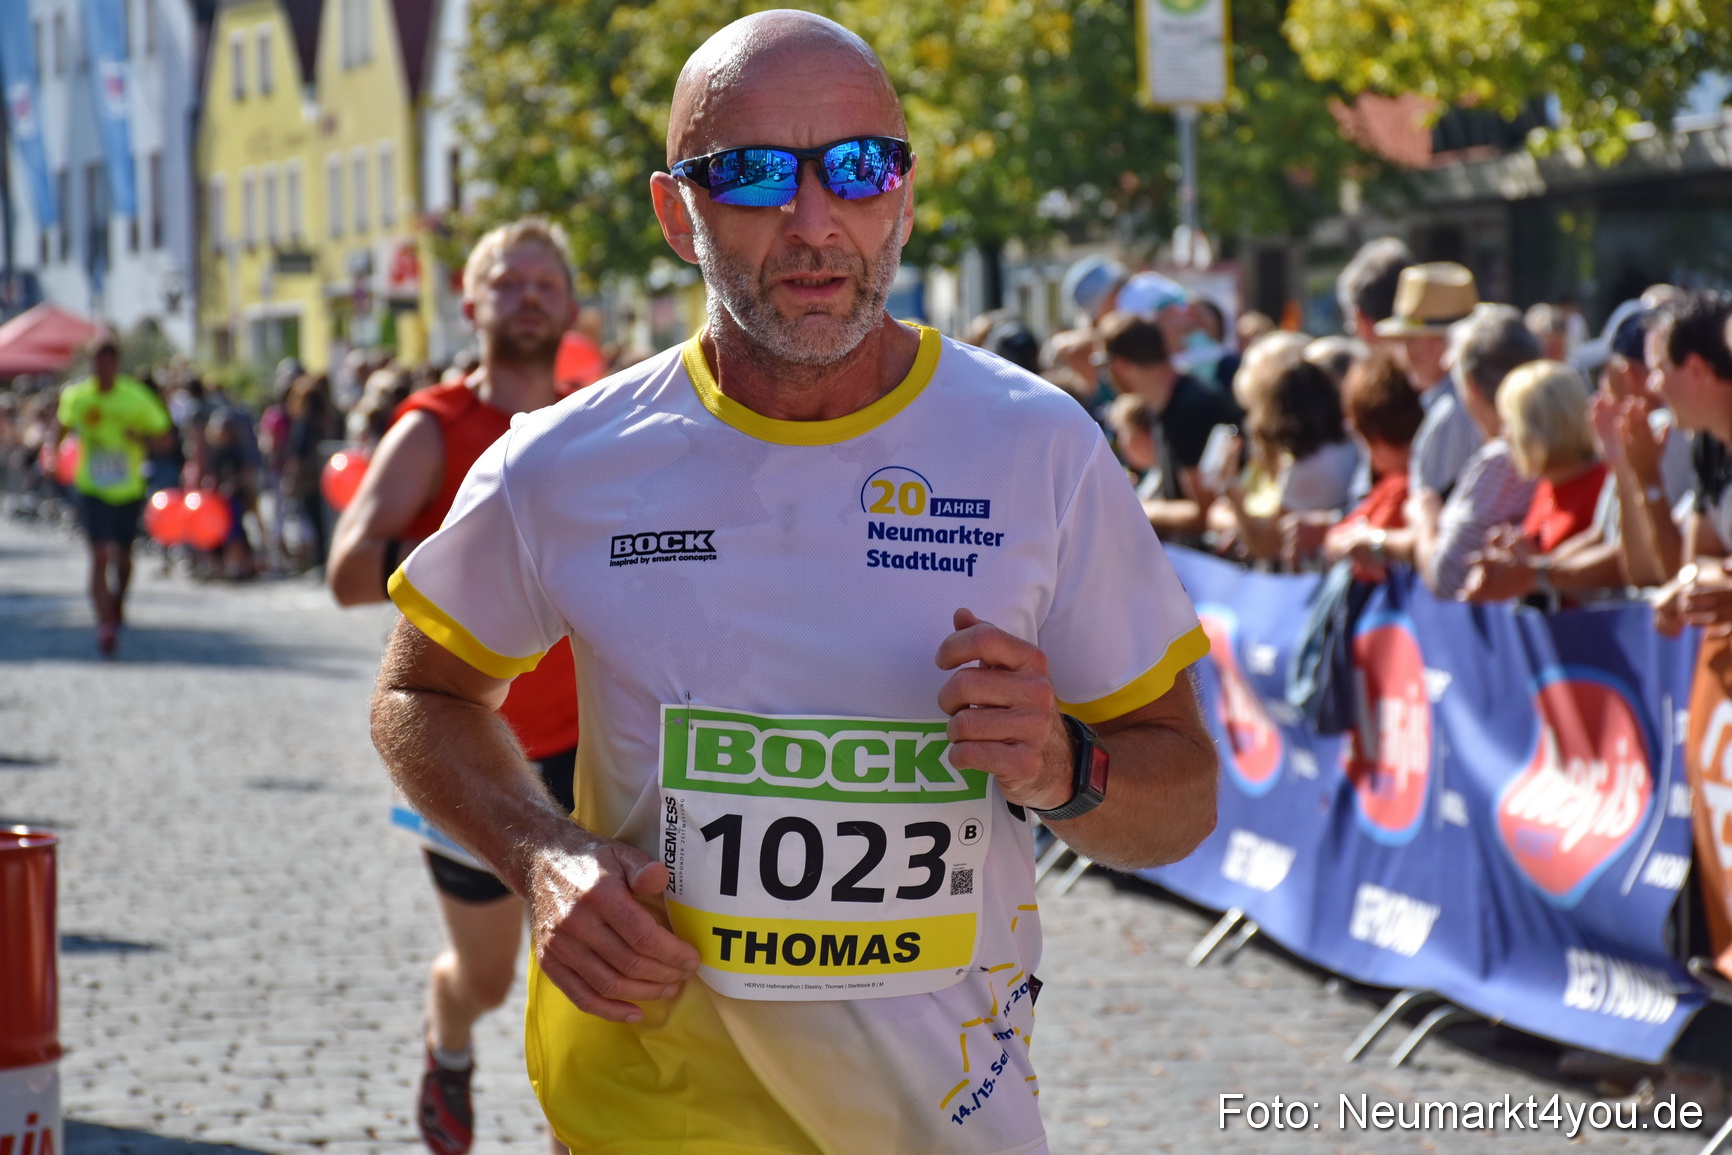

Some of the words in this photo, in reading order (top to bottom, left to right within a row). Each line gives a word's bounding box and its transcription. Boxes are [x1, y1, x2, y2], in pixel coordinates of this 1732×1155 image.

[869, 479, 926, 517] 20
[935, 501, 985, 515] JAHRE
[611, 530, 716, 559] BOCK
[867, 521, 1005, 547] Neumarkter
[609, 557, 639, 567] inspired
[640, 556, 650, 565] by
[652, 555, 676, 563] smart
[678, 553, 717, 562] concepts
[866, 549, 979, 577] Stadtlauf
[690, 723, 961, 788] BOCK
[964, 824, 977, 840] B
[699, 813, 952, 903] 1023
[712, 926, 921, 967] THOMAS
[951, 1078, 996, 1126] 14./15.
